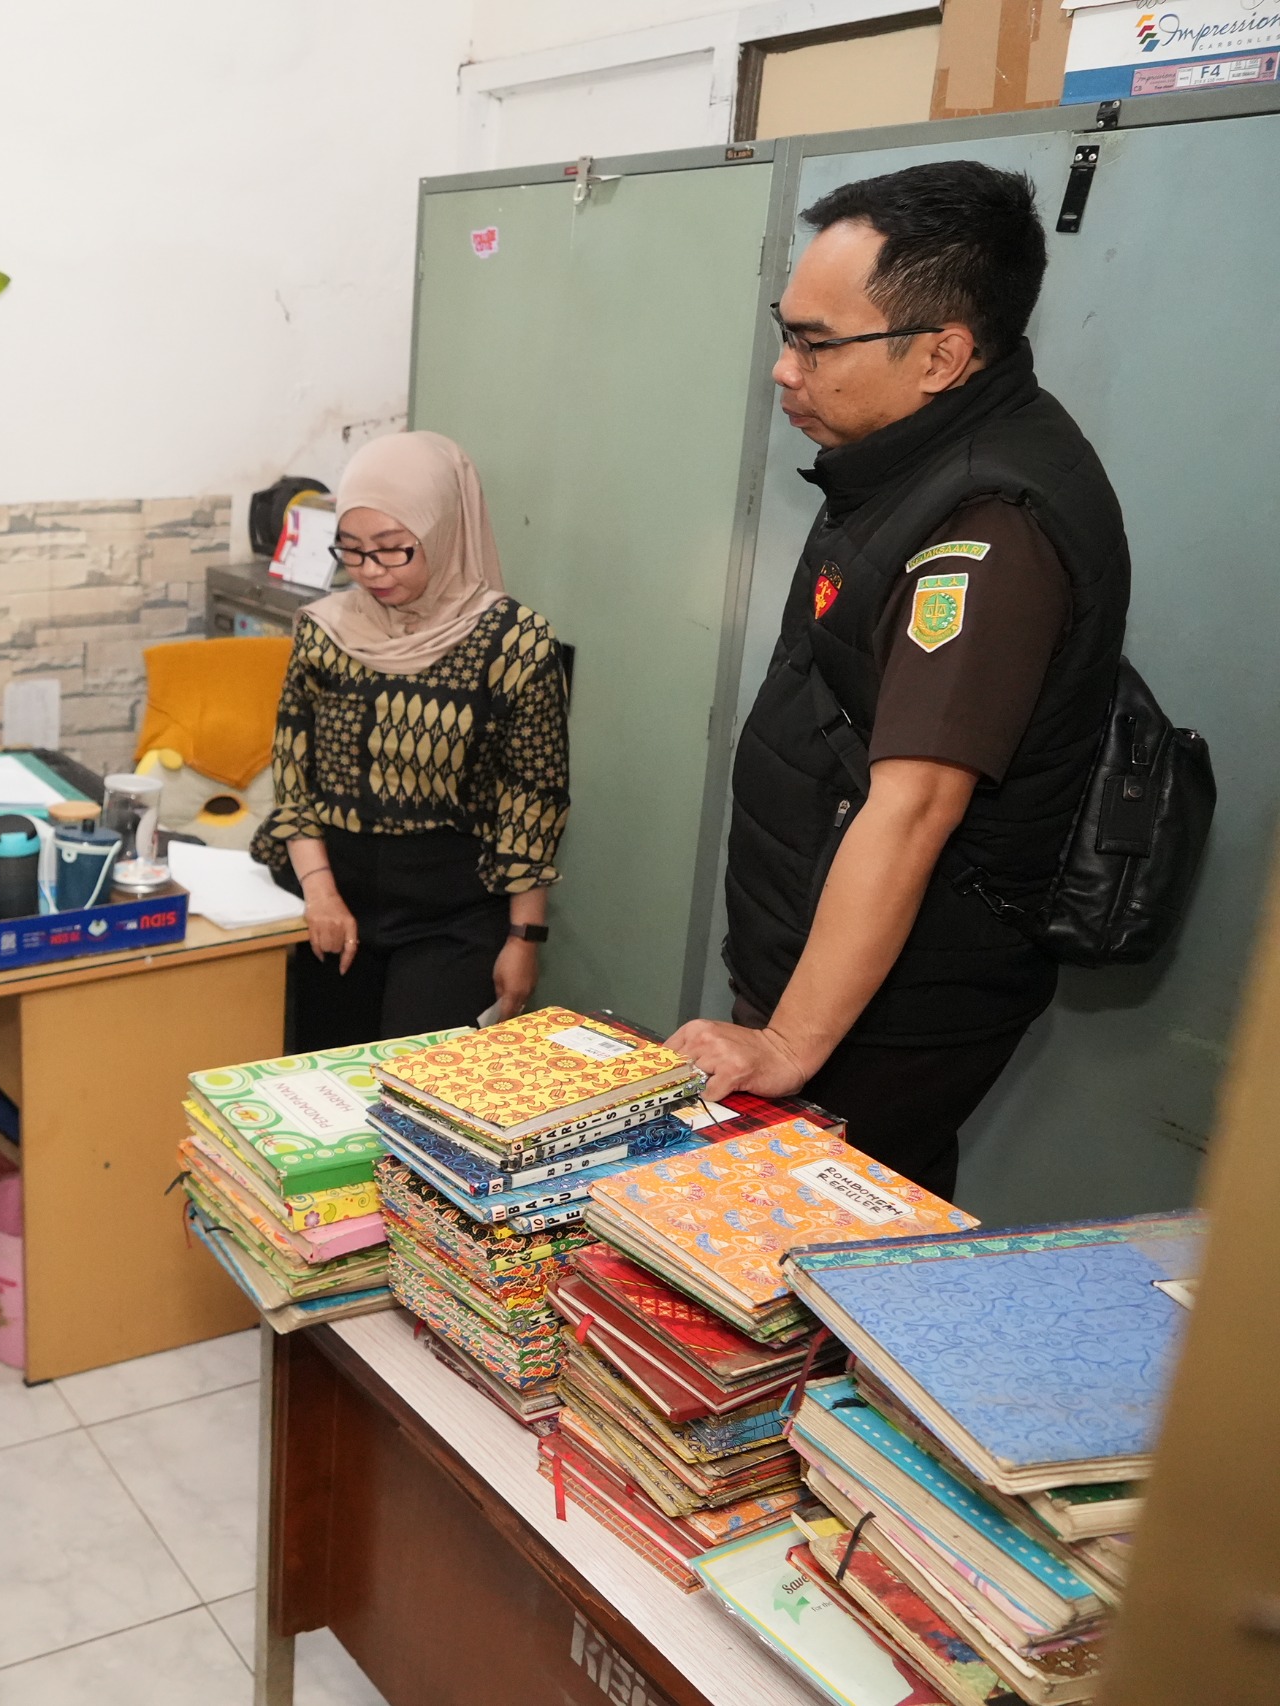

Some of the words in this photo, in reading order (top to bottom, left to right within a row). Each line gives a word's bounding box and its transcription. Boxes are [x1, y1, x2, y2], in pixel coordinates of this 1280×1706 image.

[1200, 65, 1221, 79] F4
[970, 545, 984, 555] RI
[275, 1083, 333, 1128] PENDAPATAN
[315, 1085, 354, 1112] HARIAN
[531, 1111, 617, 1145] KARCIS
[629, 1090, 684, 1113] ONTA
[548, 1131, 602, 1156] MINI
[624, 1108, 661, 1128] BUS
[492, 1182, 502, 1193] 19
[547, 1159, 590, 1178] BUS
[508, 1192, 572, 1215] BAJU
[533, 1218, 544, 1230] 10
